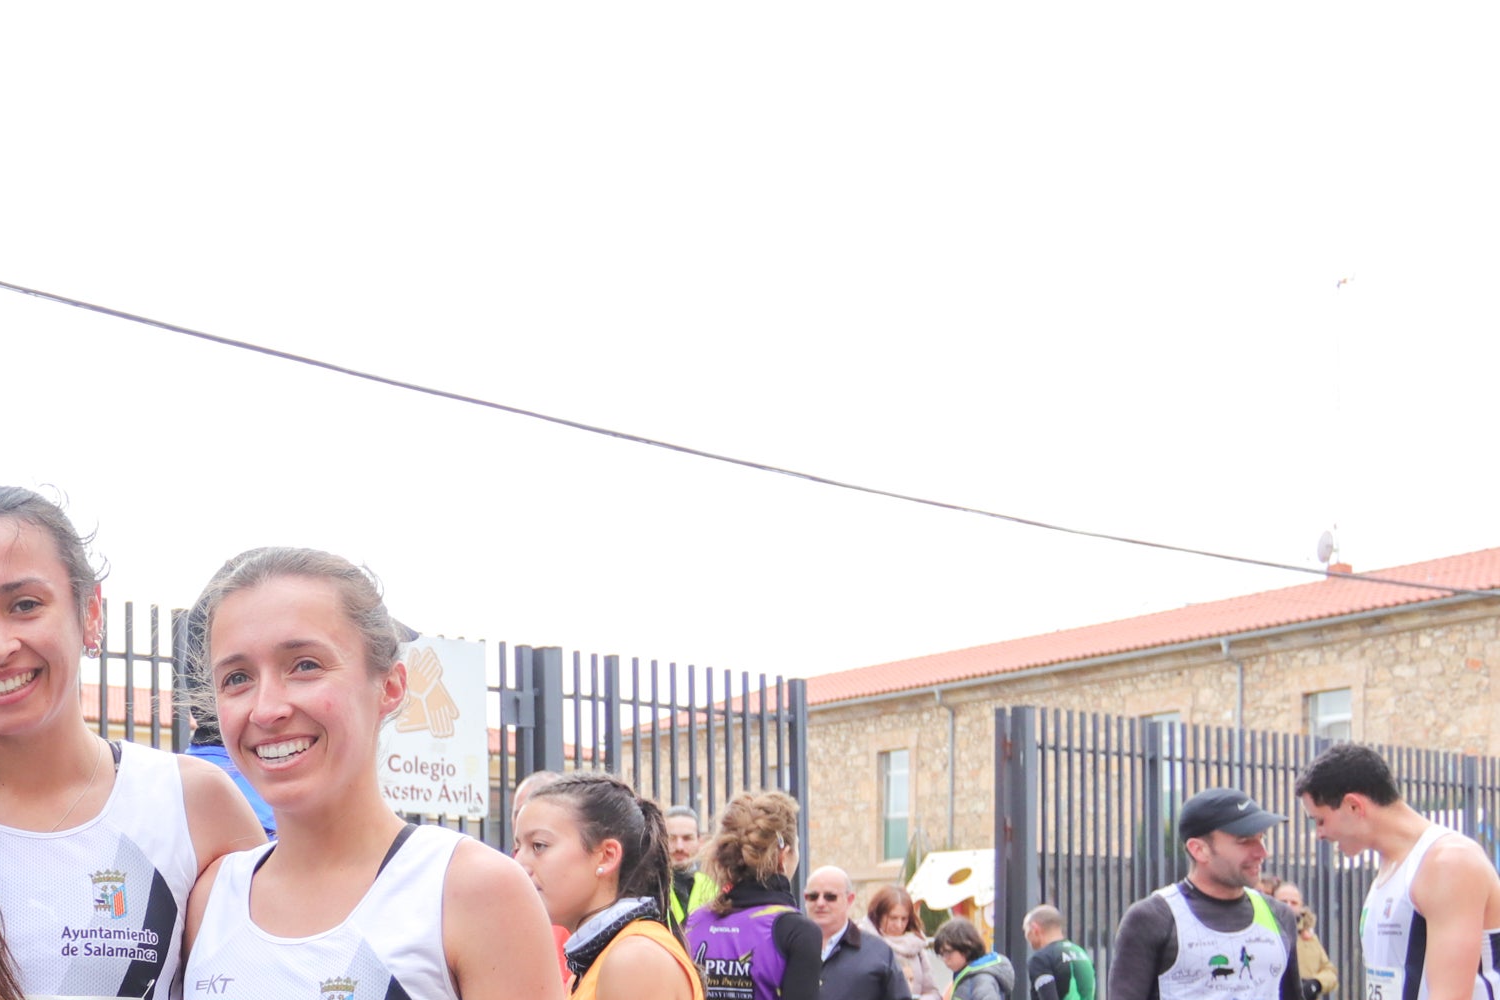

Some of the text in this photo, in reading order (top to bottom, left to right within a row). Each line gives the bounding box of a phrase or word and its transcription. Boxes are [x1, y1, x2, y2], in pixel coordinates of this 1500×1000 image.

[388, 754, 456, 781] Colegio
[384, 785, 432, 802] aestro
[61, 926, 158, 944] Ayuntamiento
[61, 943, 157, 962] de Salamanca
[706, 959, 751, 977] PRIM
[196, 974, 235, 994] EKT
